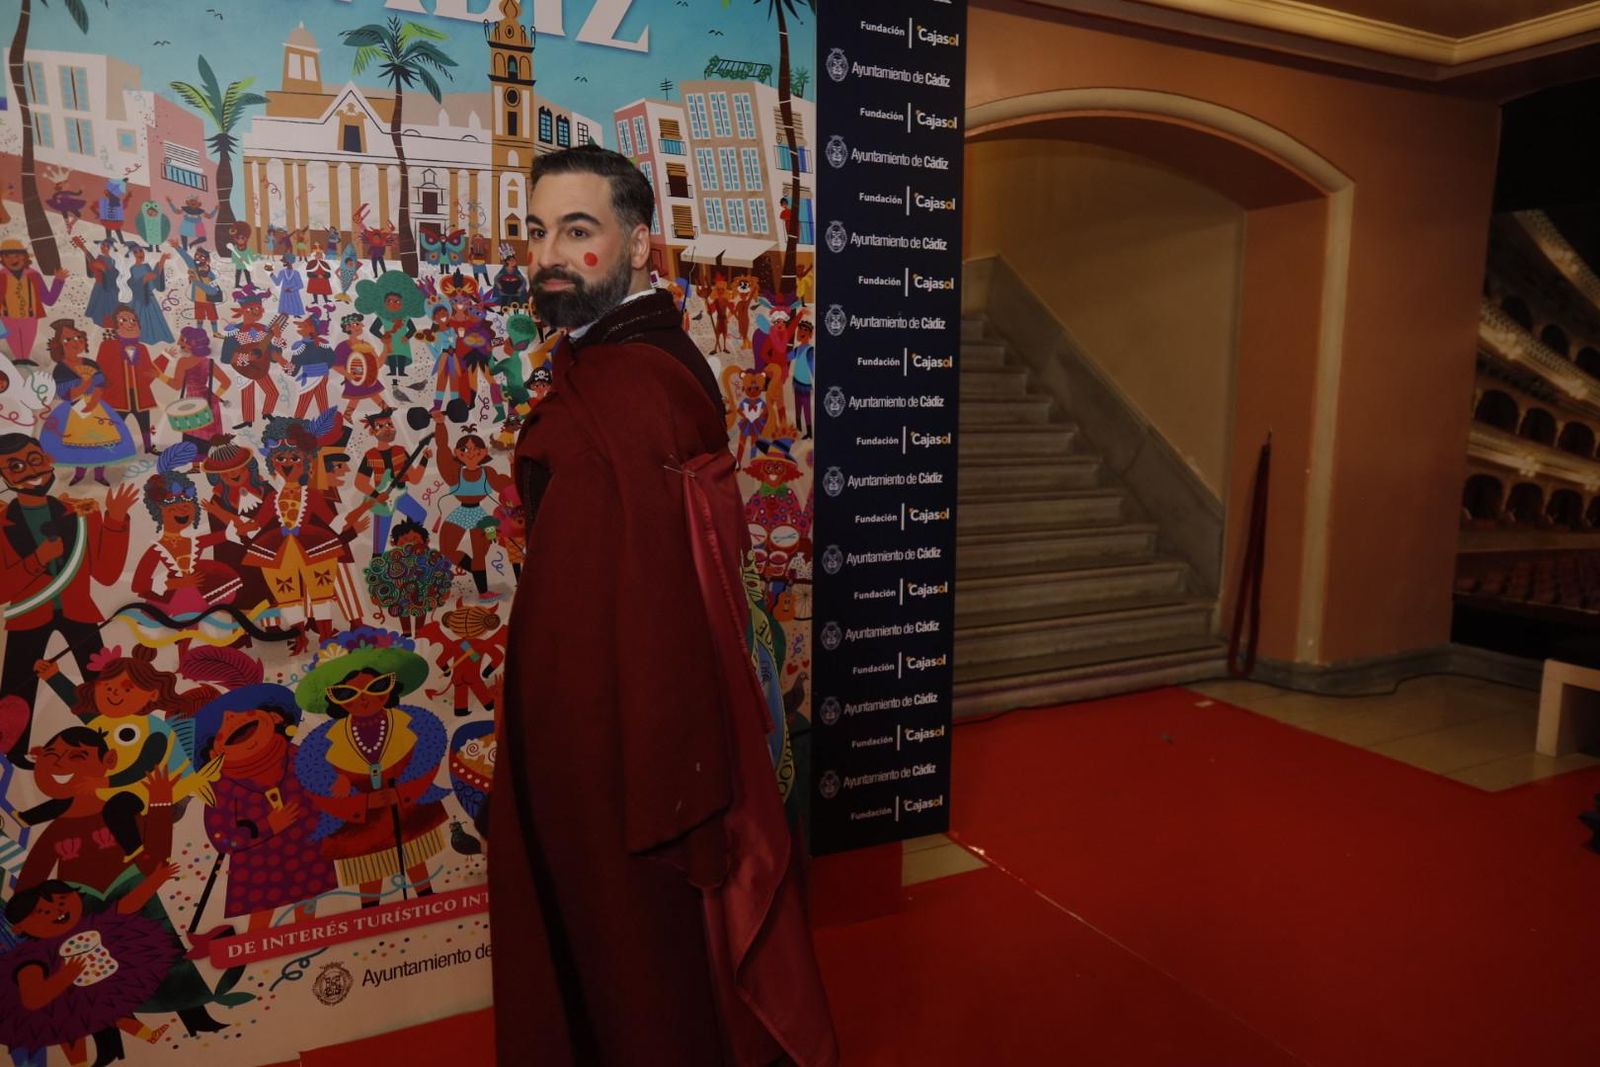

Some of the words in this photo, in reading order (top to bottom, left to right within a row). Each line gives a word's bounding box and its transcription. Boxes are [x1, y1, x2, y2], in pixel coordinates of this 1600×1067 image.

[860, 20, 904, 36] Fundación
[917, 26, 958, 46] Cajasol
[852, 62, 911, 81] Ayuntamiento
[913, 73, 923, 83] de
[925, 72, 950, 87] Cádiz
[860, 108, 903, 121] Fundación
[916, 110, 957, 130] Cajasol
[851, 148, 910, 166] Ayuntamiento
[912, 156, 922, 167] de
[924, 156, 948, 169] Cádiz
[859, 192, 902, 205] Fundación
[914, 193, 955, 212] Cajasol
[850, 232, 908, 248] Ayuntamiento
[910, 238, 921, 249] de
[923, 237, 947, 250] Cádiz
[858, 276, 901, 286] Fundación
[913, 274, 954, 292] Cajasol
[850, 315, 907, 330] Ayuntamiento
[909, 318, 920, 329] de
[921, 317, 946, 330] Cádiz
[857, 356, 900, 366] Fundación
[912, 354, 952, 371] Cajasol
[849, 396, 907, 412] Ayuntamiento
[908, 398, 919, 407] de
[920, 395, 944, 407] Cádiz
[856, 436, 898, 446] Fundación
[910, 432, 951, 448] Cajasol
[848, 475, 905, 489] Ayuntamiento
[907, 475, 917, 484] de
[919, 472, 943, 484] Cádiz
[855, 513, 897, 523] Fundación
[909, 508, 949, 524] Cajasol
[846, 552, 904, 566] Ayuntamiento
[905, 550, 915, 560] de
[917, 547, 942, 559] Cádiz
[854, 588, 896, 600] Fundación
[908, 581, 948, 598] Cajasol
[845, 624, 902, 642] Ayuntamiento
[903, 623, 913, 633] de
[915, 620, 940, 632] Cádiz
[853, 663, 894, 674] Fundación
[906, 654, 946, 671] Cajasol
[844, 698, 900, 716] Ayuntamiento
[901, 696, 912, 707] de
[914, 692, 938, 706] Cádiz
[852, 736, 893, 748] Fundación
[904, 725, 944, 742] Cajasol
[842, 770, 899, 788] Ayuntamiento
[900, 768, 911, 779] de
[912, 763, 936, 777] Cádiz
[850, 807, 892, 820] Fundación
[904, 795, 943, 812] Cajasol
[228, 940, 256, 958] DE
[262, 920, 348, 950] INTERÉS
[353, 900, 458, 930] TURÍSTICO
[362, 947, 471, 987] Ayuntamiento
[475, 943, 493, 960] de
